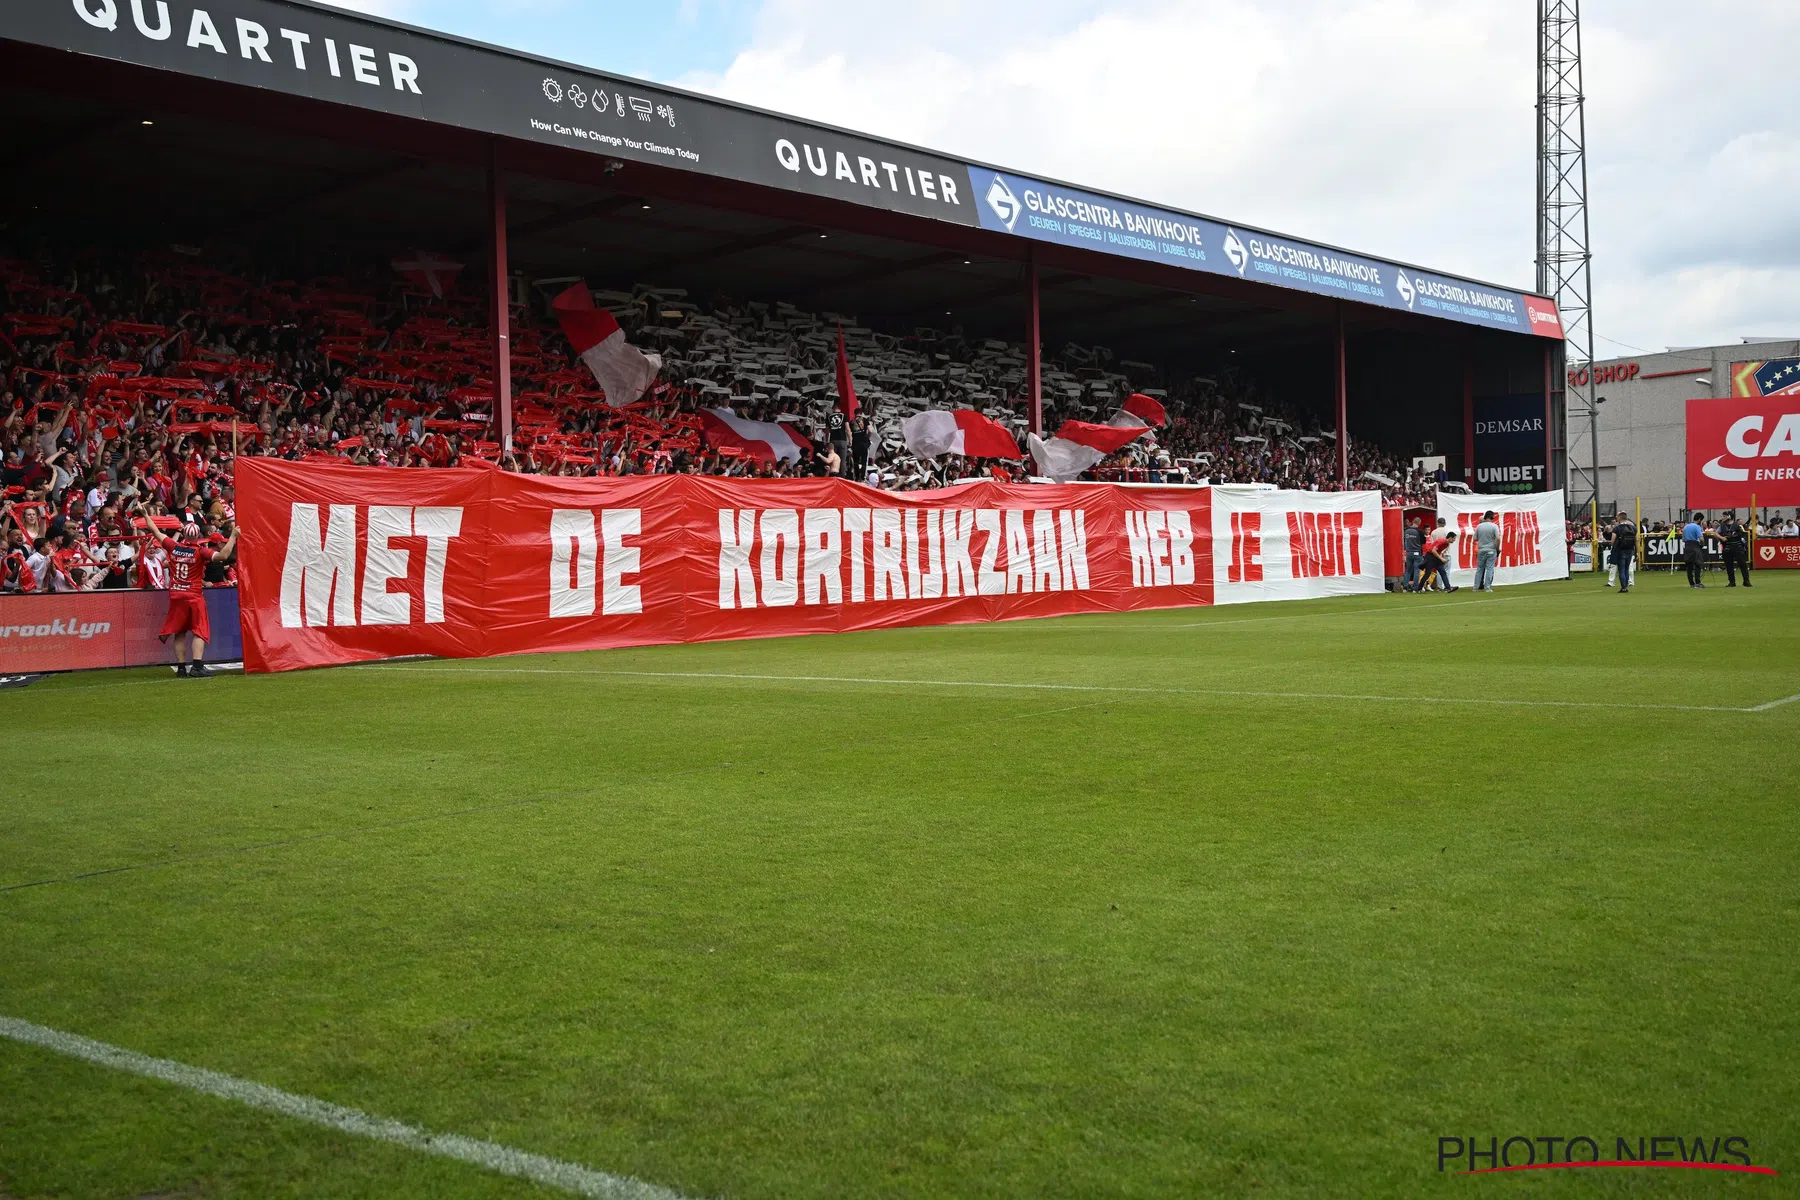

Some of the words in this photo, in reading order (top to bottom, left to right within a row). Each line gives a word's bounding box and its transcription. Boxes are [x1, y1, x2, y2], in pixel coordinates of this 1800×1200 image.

[72, 0, 423, 95] QUARTIER
[530, 118, 552, 132] How
[553, 123, 572, 136] Can
[573, 126, 588, 139] We
[589, 130, 622, 146] Change
[623, 137, 642, 150] Your
[643, 141, 676, 156] Climate
[676, 147, 700, 162] Today
[776, 138, 961, 206] QUARTIER
[1024, 189, 1124, 230] GLASCENTRA
[1124, 211, 1203, 246] BAVIKHOVE
[1028, 215, 1062, 232] DEUREN
[1068, 224, 1102, 241] SPIEGELS
[1108, 232, 1157, 252] BALUSTRADEN
[1162, 243, 1188, 258] DUBBEL
[1188, 247, 1206, 261] GLAS
[1249, 239, 1323, 272] GLASCENTRA
[1322, 256, 1382, 284] BAVIKHOVE
[1253, 260, 1278, 275] DEUREN
[1282, 267, 1308, 281] SPIEGELS
[1311, 273, 1348, 290] BALUSTRADEN
[1351, 281, 1371, 294] DUBBEL
[1371, 286, 1385, 298] GLAS
[1415, 278, 1469, 303] GLASCENTRA
[1470, 289, 1516, 313] BAVIKHOVE
[1593, 362, 1640, 385] SHOP
[1475, 418, 1544, 435] DEMSAR
[1477, 464, 1545, 483] UNIBET
[279, 502, 465, 628] MET
[549, 508, 643, 619] DE
[718, 508, 1091, 610] KORTRIJKZAAN
[1125, 510, 1196, 588] HEB
[1228, 512, 1264, 583] JE
[1786, 553, 1800, 562] SE
